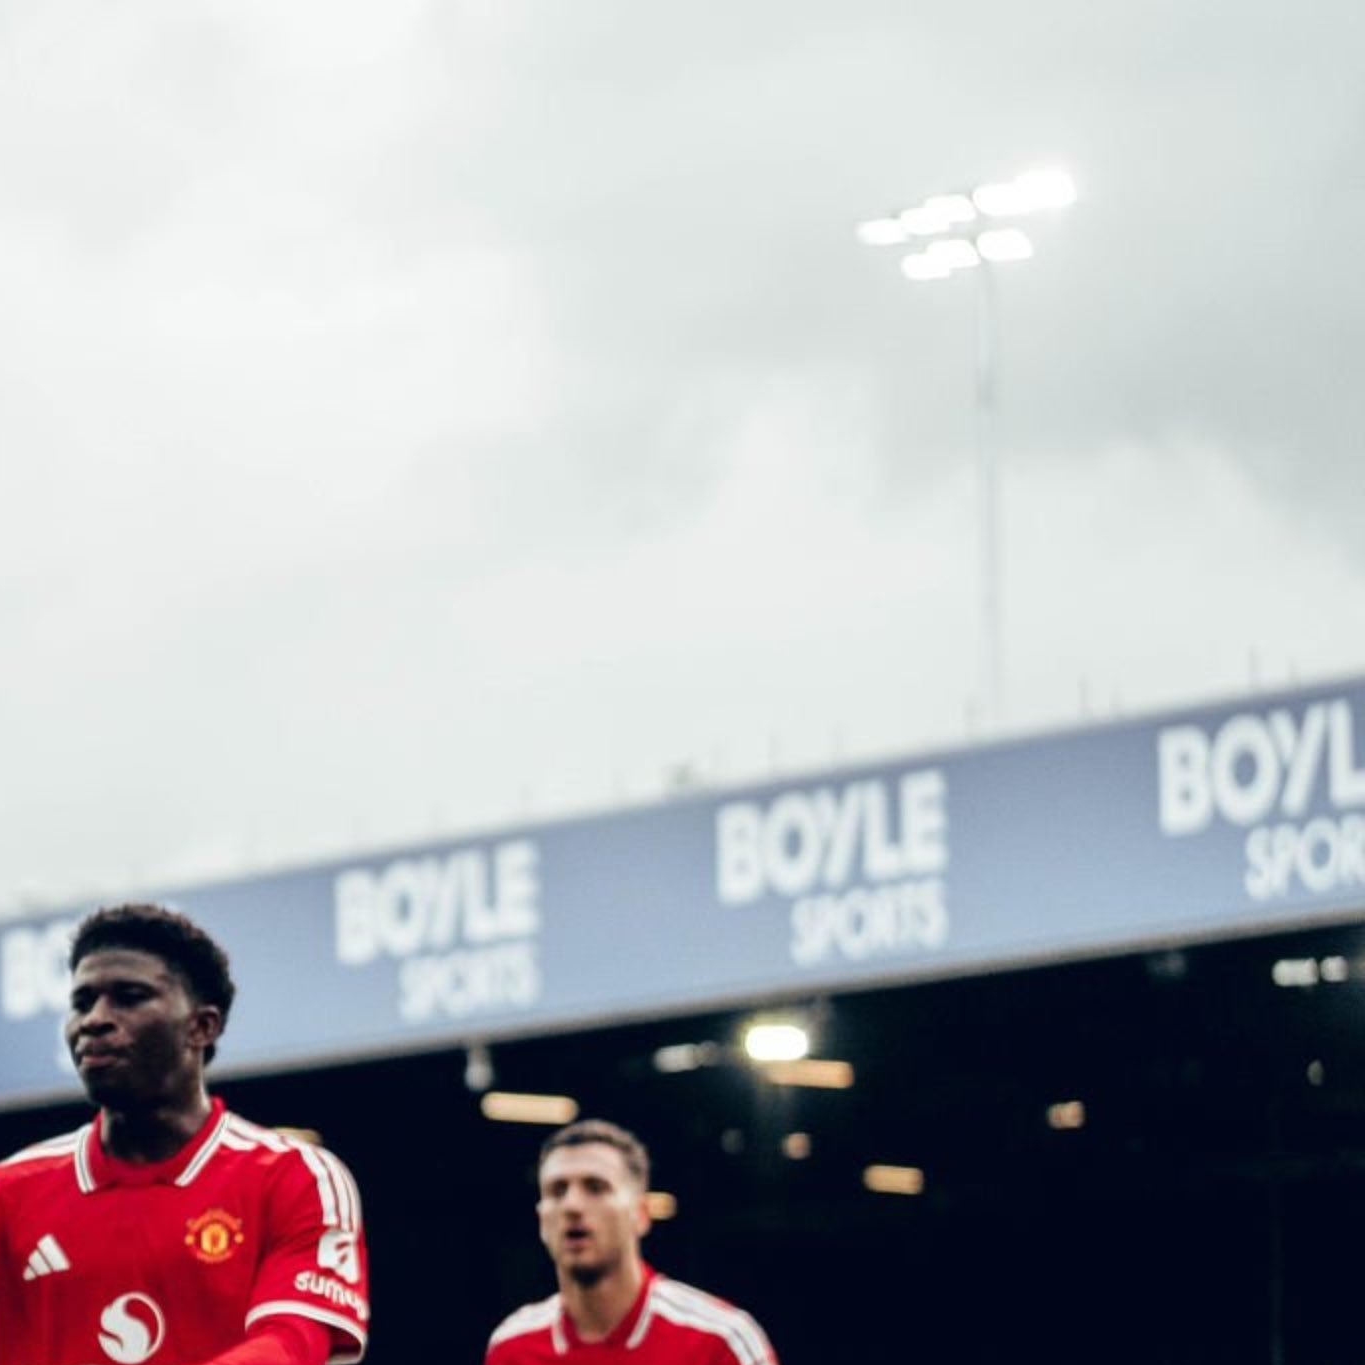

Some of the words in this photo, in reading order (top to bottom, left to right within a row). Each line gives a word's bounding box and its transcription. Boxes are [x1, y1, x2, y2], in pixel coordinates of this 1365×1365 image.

[716, 769, 949, 905] BOYLE
[333, 839, 542, 967] BOYLE
[790, 880, 949, 968] SPORTS
[397, 943, 542, 1024] SPORTS
